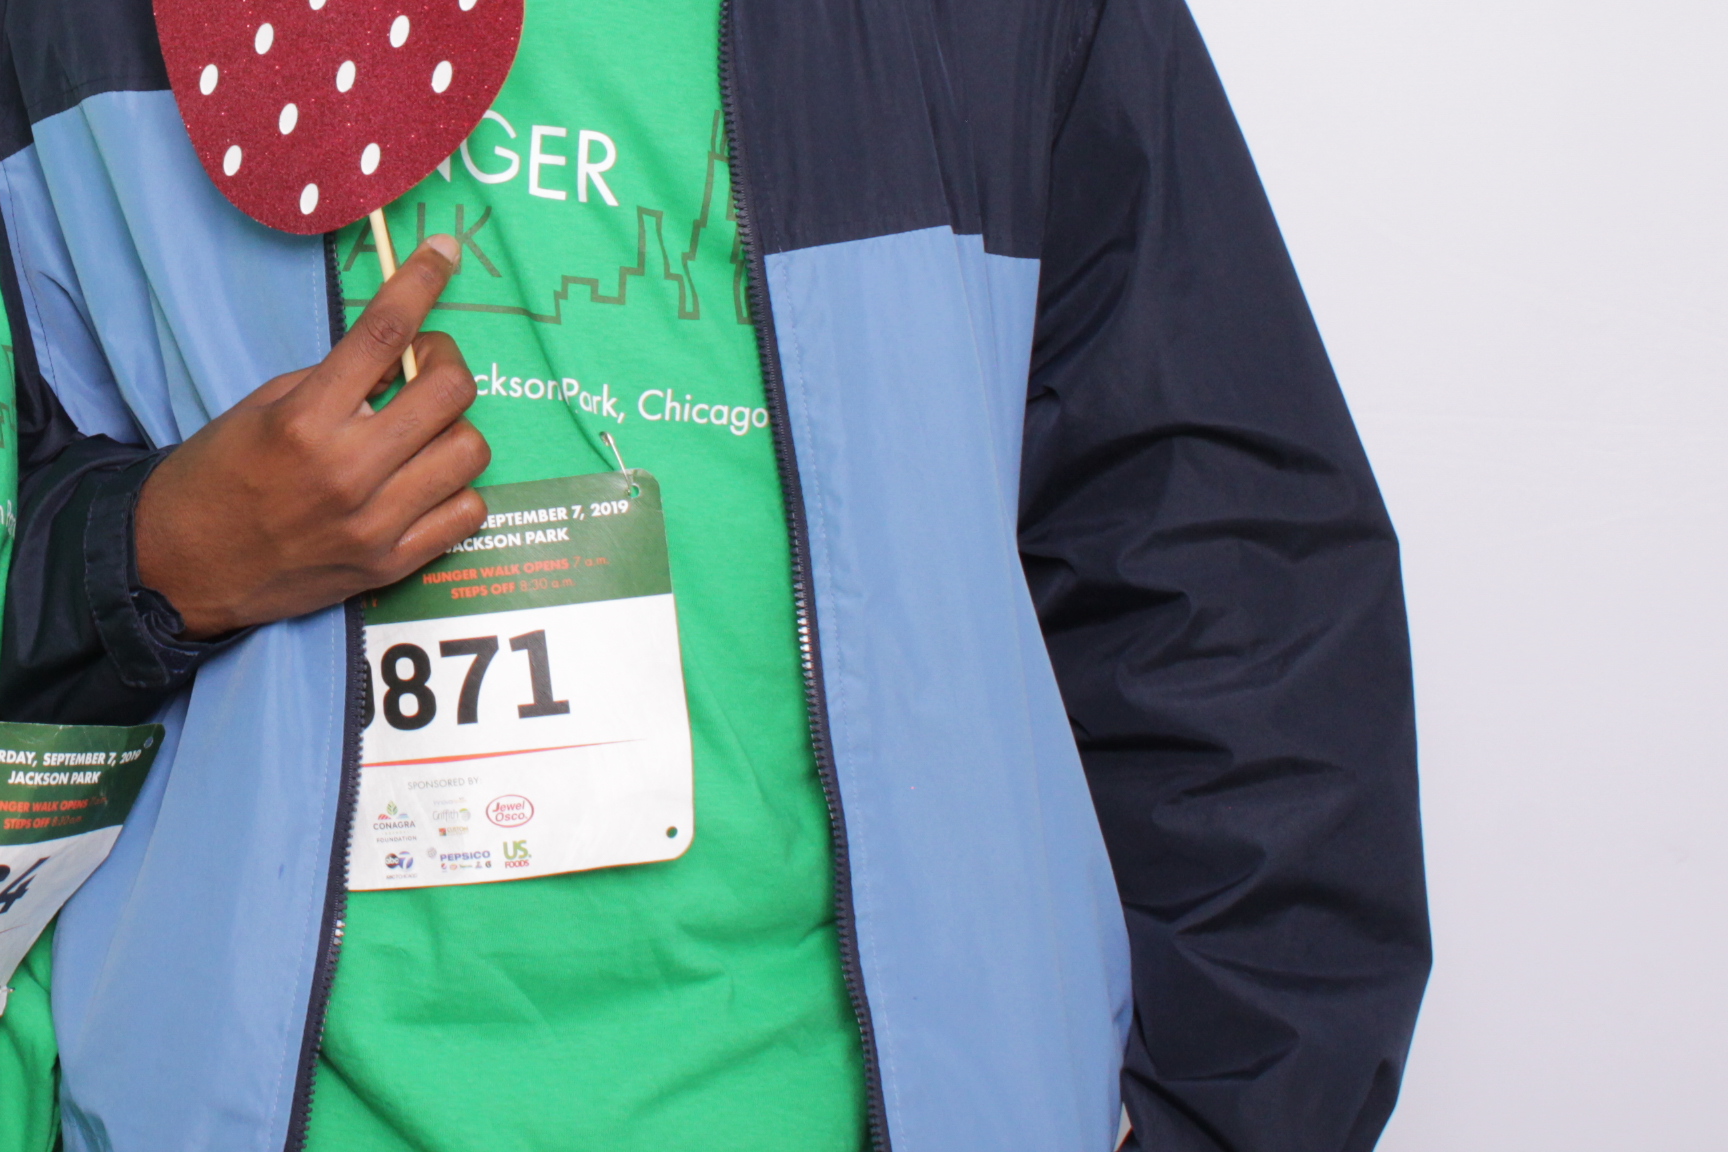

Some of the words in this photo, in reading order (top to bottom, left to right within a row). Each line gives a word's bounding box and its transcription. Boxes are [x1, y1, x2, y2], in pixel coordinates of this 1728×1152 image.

[571, 504, 585, 520] 7,
[590, 499, 630, 517] 2019
[525, 527, 570, 545] PARK
[423, 567, 479, 585] HUNGER
[480, 563, 521, 580] WALK
[523, 558, 570, 575] OPENS
[573, 556, 582, 569] 7
[584, 556, 609, 568] a.m.
[450, 585, 489, 600] STEPS
[490, 581, 516, 595] OFF
[519, 578, 549, 592] 8:30
[550, 578, 576, 590] a.m.
[42, 752, 106, 766] SEPTEMBER
[106, 751, 117, 767] 7,
[119, 749, 142, 765] 2019
[7, 770, 69, 785] JACKSON
[69, 771, 101, 785] PARK
[407, 778, 465, 790] SPONSORED
[32, 800, 59, 812] WALK
[492, 800, 525, 812] Jewel
[3, 817, 32, 830] STEPS
[32, 817, 51, 829] OFF
[373, 820, 416, 831] CONAGRA
[440, 851, 491, 862] PEPSICO
[505, 860, 529, 869] FOODS
